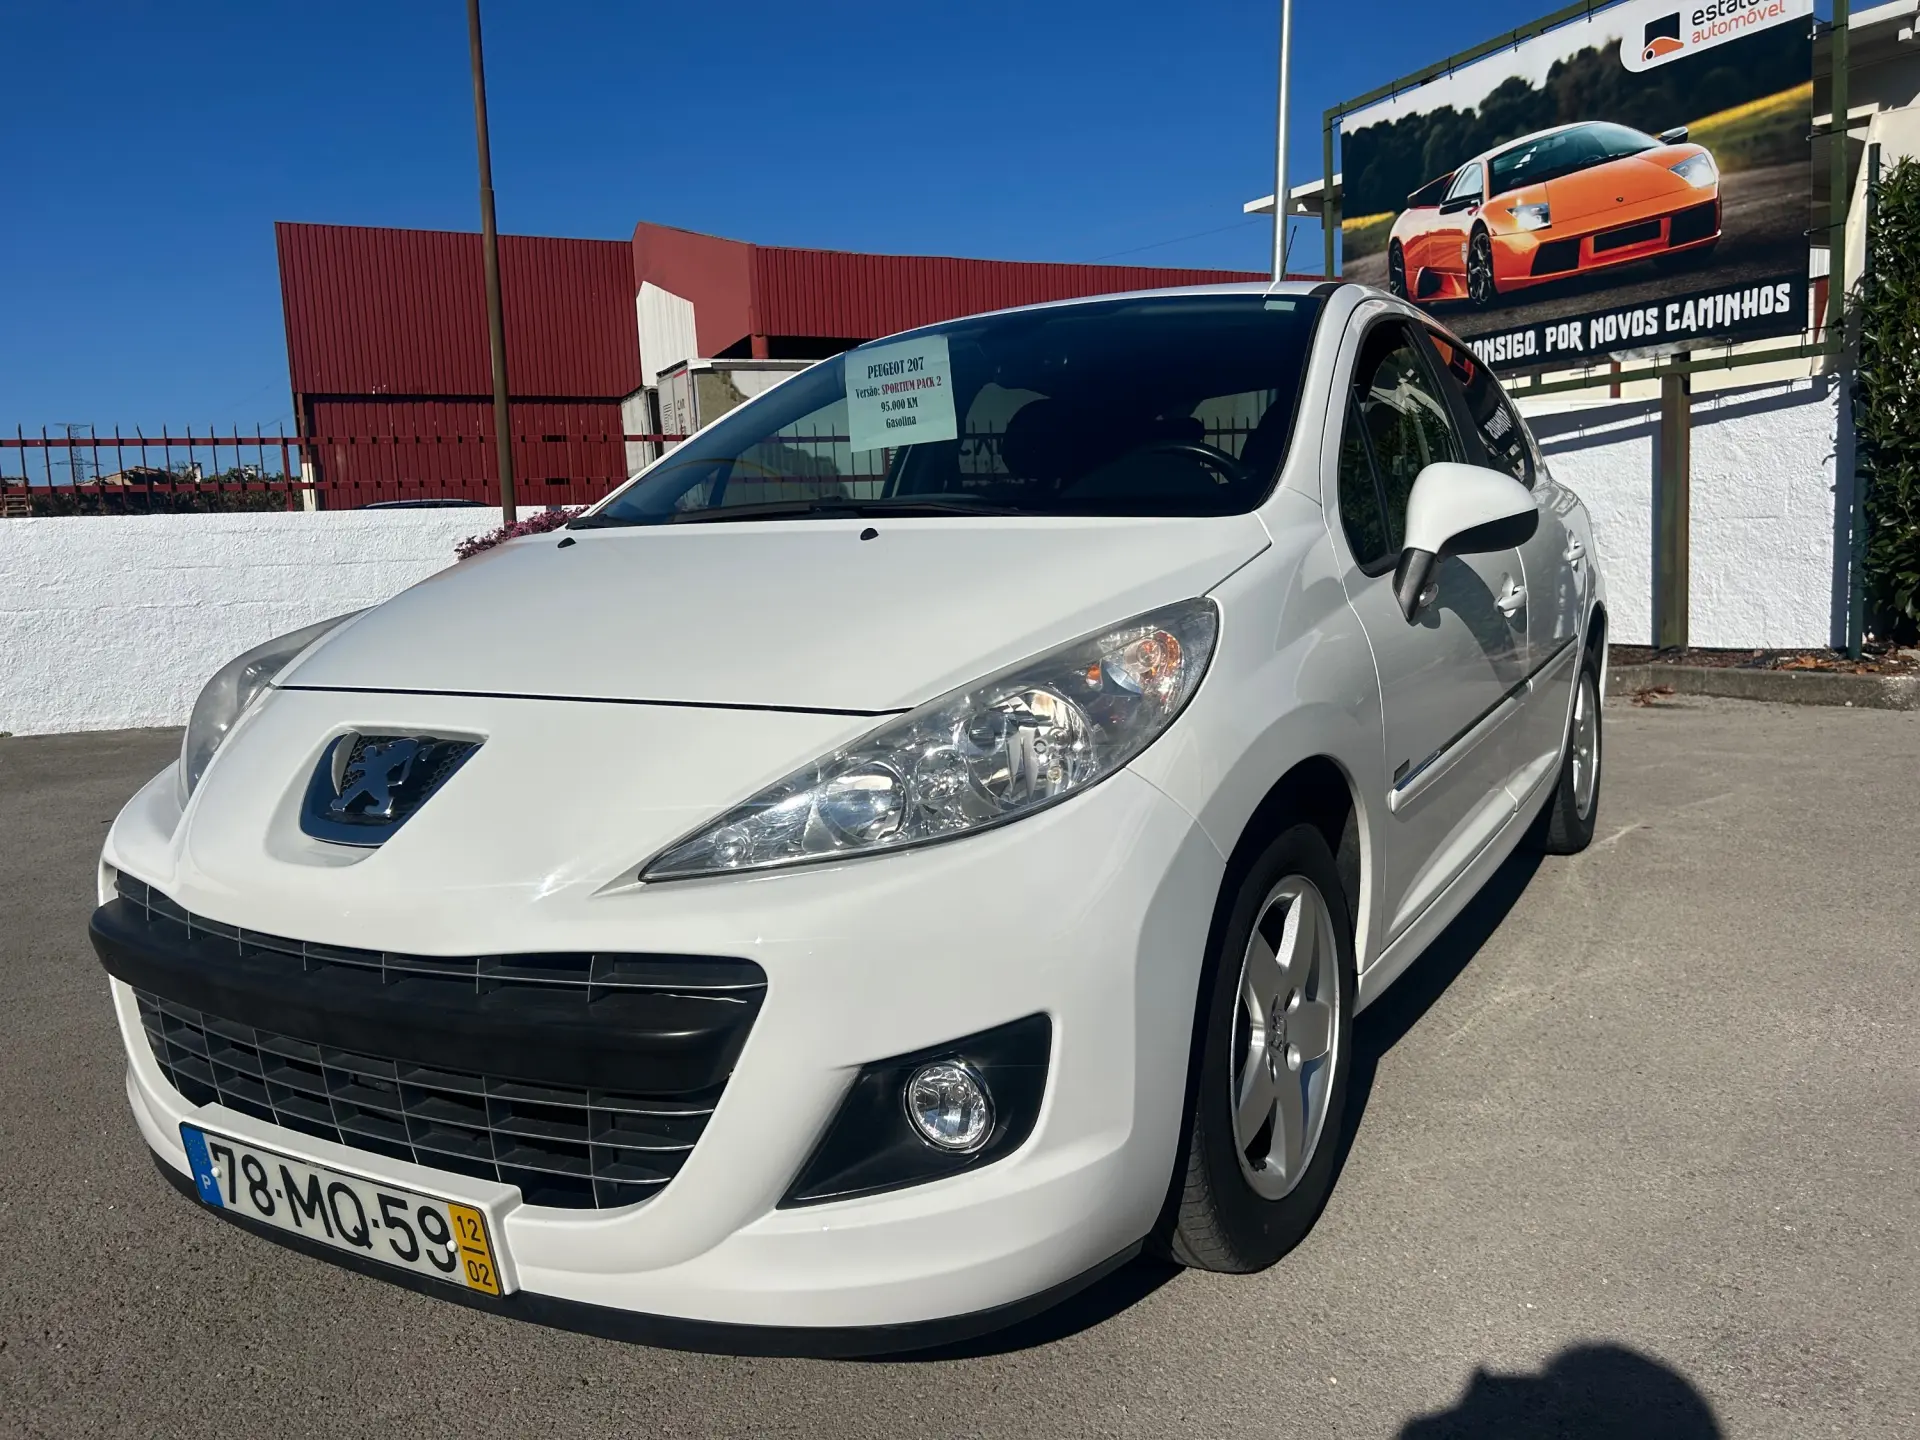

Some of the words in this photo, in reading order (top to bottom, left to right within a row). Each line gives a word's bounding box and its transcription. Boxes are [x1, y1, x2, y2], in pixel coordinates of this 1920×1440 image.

[1692, 0, 1786, 43] automóvel
[1545, 321, 1584, 352] POR
[1590, 307, 1658, 349] NOVOS
[1665, 283, 1791, 332] CAMINHOS
[868, 360, 905, 379] PEUGEOT
[907, 356, 924, 372] 207
[856, 386, 881, 399] Versão:
[881, 380, 915, 395] SPORTIUM
[916, 376, 935, 390] PACK
[936, 375, 942, 386] 2
[880, 399, 906, 413] 95.000
[907, 396, 919, 409] KM
[886, 415, 917, 428] Gasolina
[201, 1174, 211, 1190] P
[456, 1215, 481, 1242] 12
[467, 1259, 493, 1287] 02
